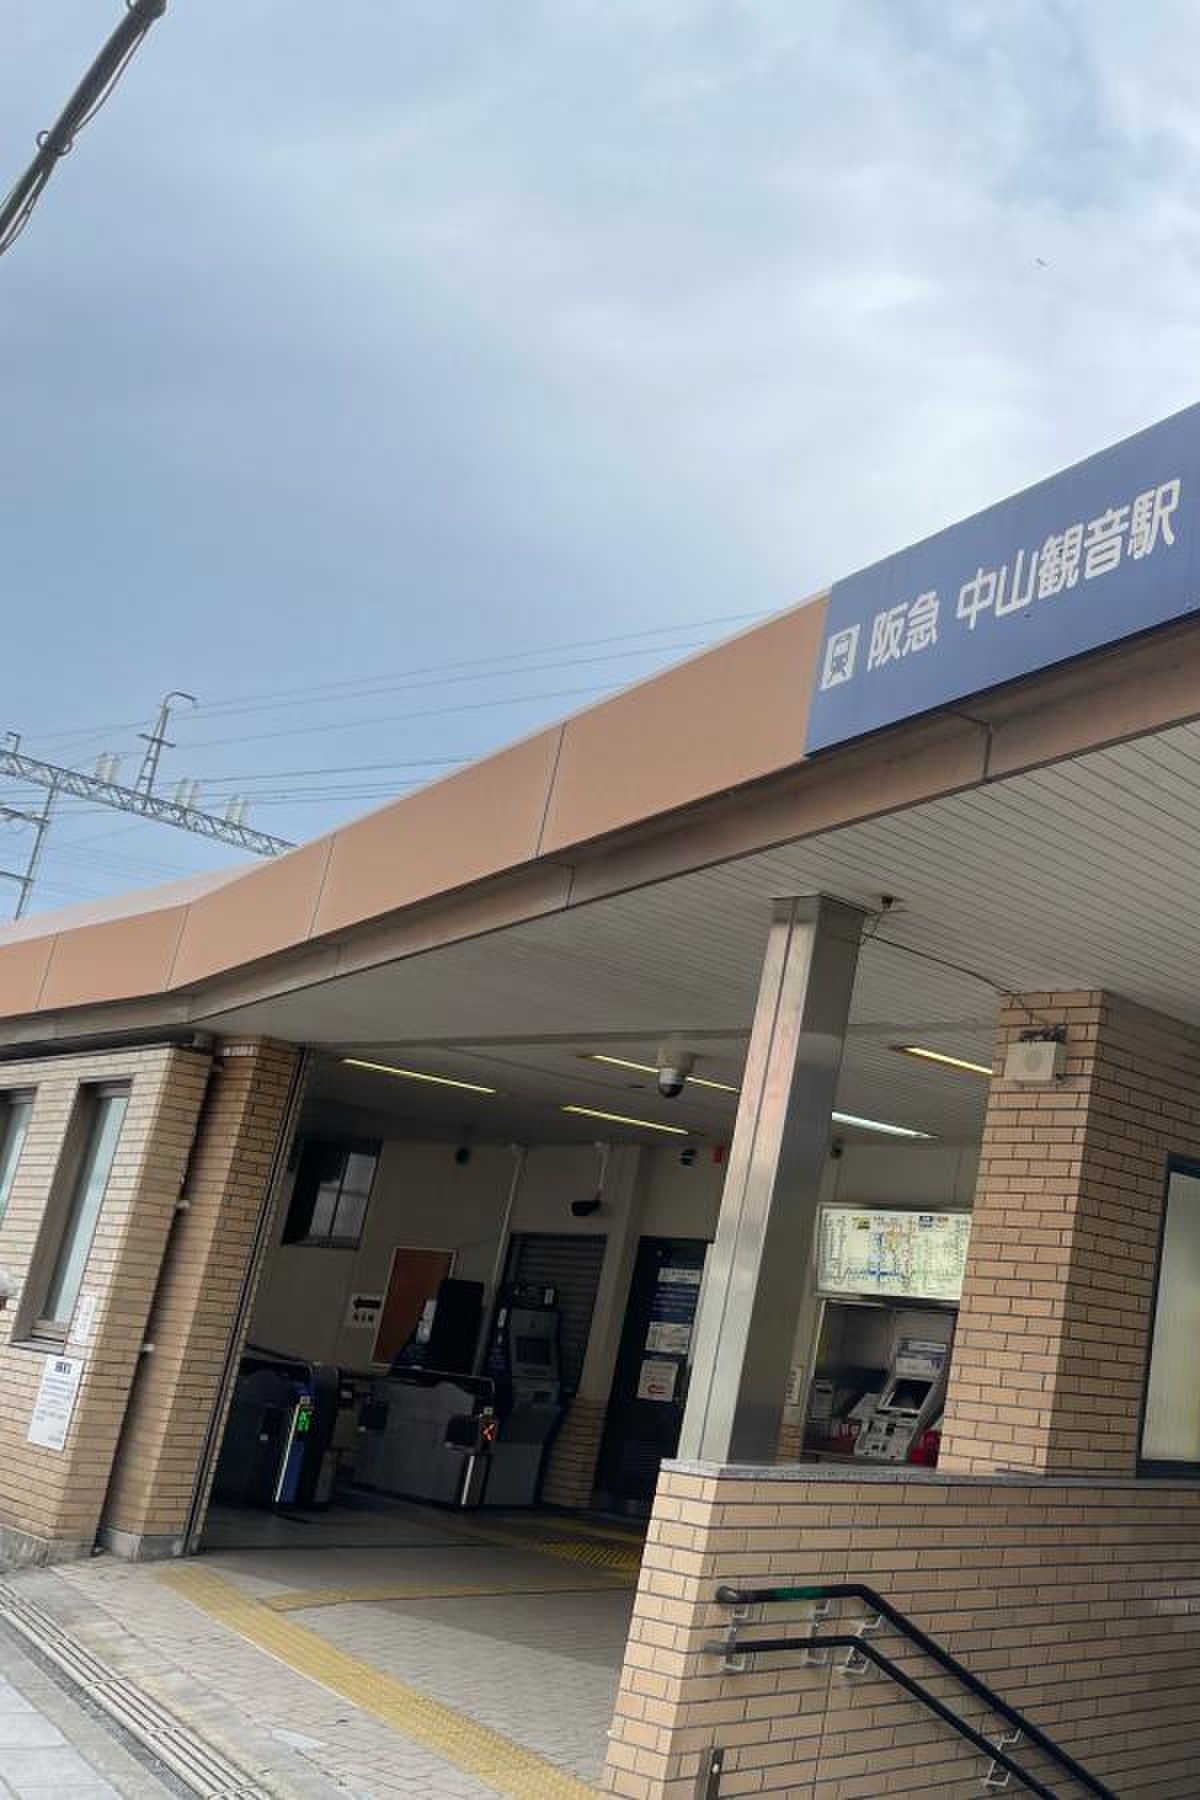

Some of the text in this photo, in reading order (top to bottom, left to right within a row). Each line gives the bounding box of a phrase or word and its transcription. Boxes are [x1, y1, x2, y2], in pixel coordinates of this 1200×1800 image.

[866, 479, 1181, 672] 阪急 中山観音駅
